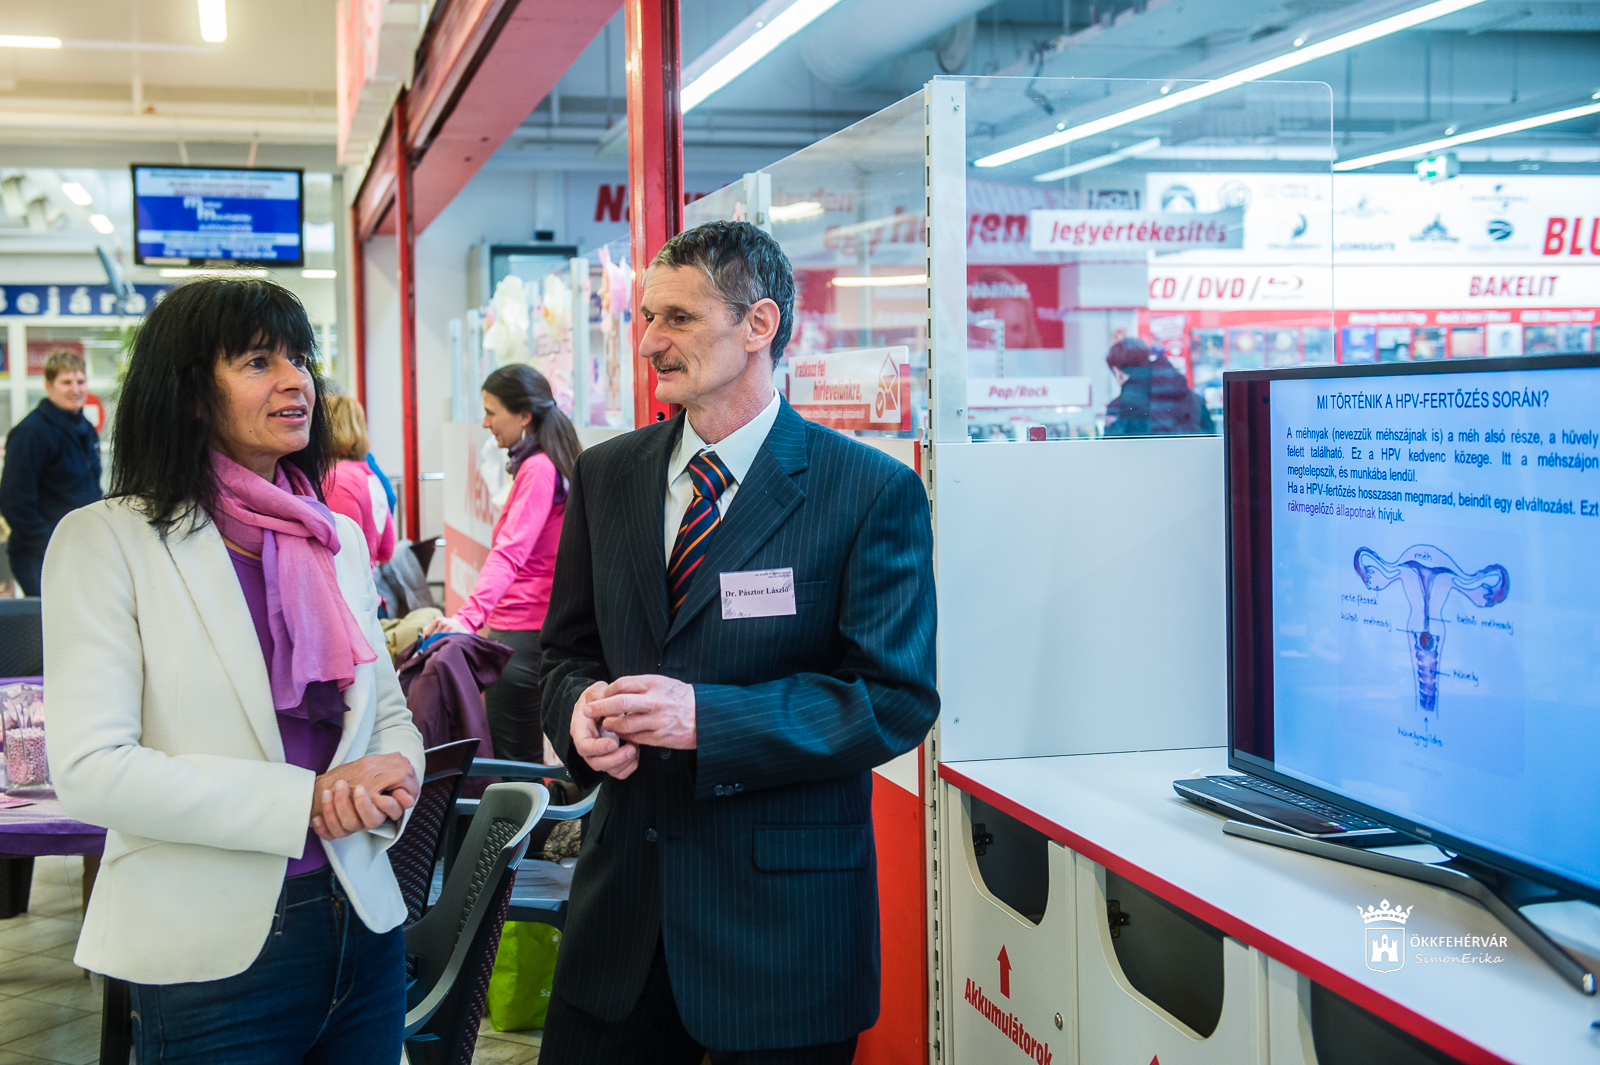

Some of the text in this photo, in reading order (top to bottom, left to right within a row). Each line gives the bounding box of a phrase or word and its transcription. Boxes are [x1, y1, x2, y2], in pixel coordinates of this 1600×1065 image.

[1050, 219, 1229, 246] Jegyértékesítés
[1149, 277, 1176, 300] CD
[1198, 277, 1246, 300] DVD
[1469, 276, 1560, 297] BAKELIT
[0, 285, 170, 319] ejára
[818, 359, 826, 377] fel
[988, 385, 1049, 400] Pop/Rock
[1316, 387, 1550, 409] MI TÖRTÉNIK A HPV-FERTŐZÉS SORÁN?
[1286, 427, 1293, 439] A
[1296, 427, 1329, 442] méhnyak
[1332, 427, 1372, 443] (nevezzük
[1376, 427, 1427, 444] méhszájnak
[1431, 427, 1444, 445] is)
[1447, 431, 1454, 442] a
[1458, 428, 1480, 443] méh
[1485, 428, 1506, 443] alsó
[1511, 429, 1543, 446] része,
[1549, 432, 1556, 444] a
[1286, 445, 1600, 472] felett található. Ez a HPV kedvenc közege. Itt a méhszájon
[1287, 465, 1418, 482] megtelepszik, és munkába lendül.
[1287, 481, 1298, 494] Ha
[1299, 485, 1305, 494] a
[1358, 486, 1403, 501] hosszasan
[1405, 491, 1456, 507] megmarad,
[1458, 492, 1492, 508] beindít
[1494, 497, 1513, 514] egy
[1515, 496, 1576, 515] elváltozást.
[1580, 499, 1600, 517] Ezt
[1336, 503, 1377, 520] állapotnak
[1378, 507, 1406, 524] hívjuk.
[725, 586, 789, 598] Dr. Pásztor László
[964, 977, 1053, 1065] Akkumulátorok
